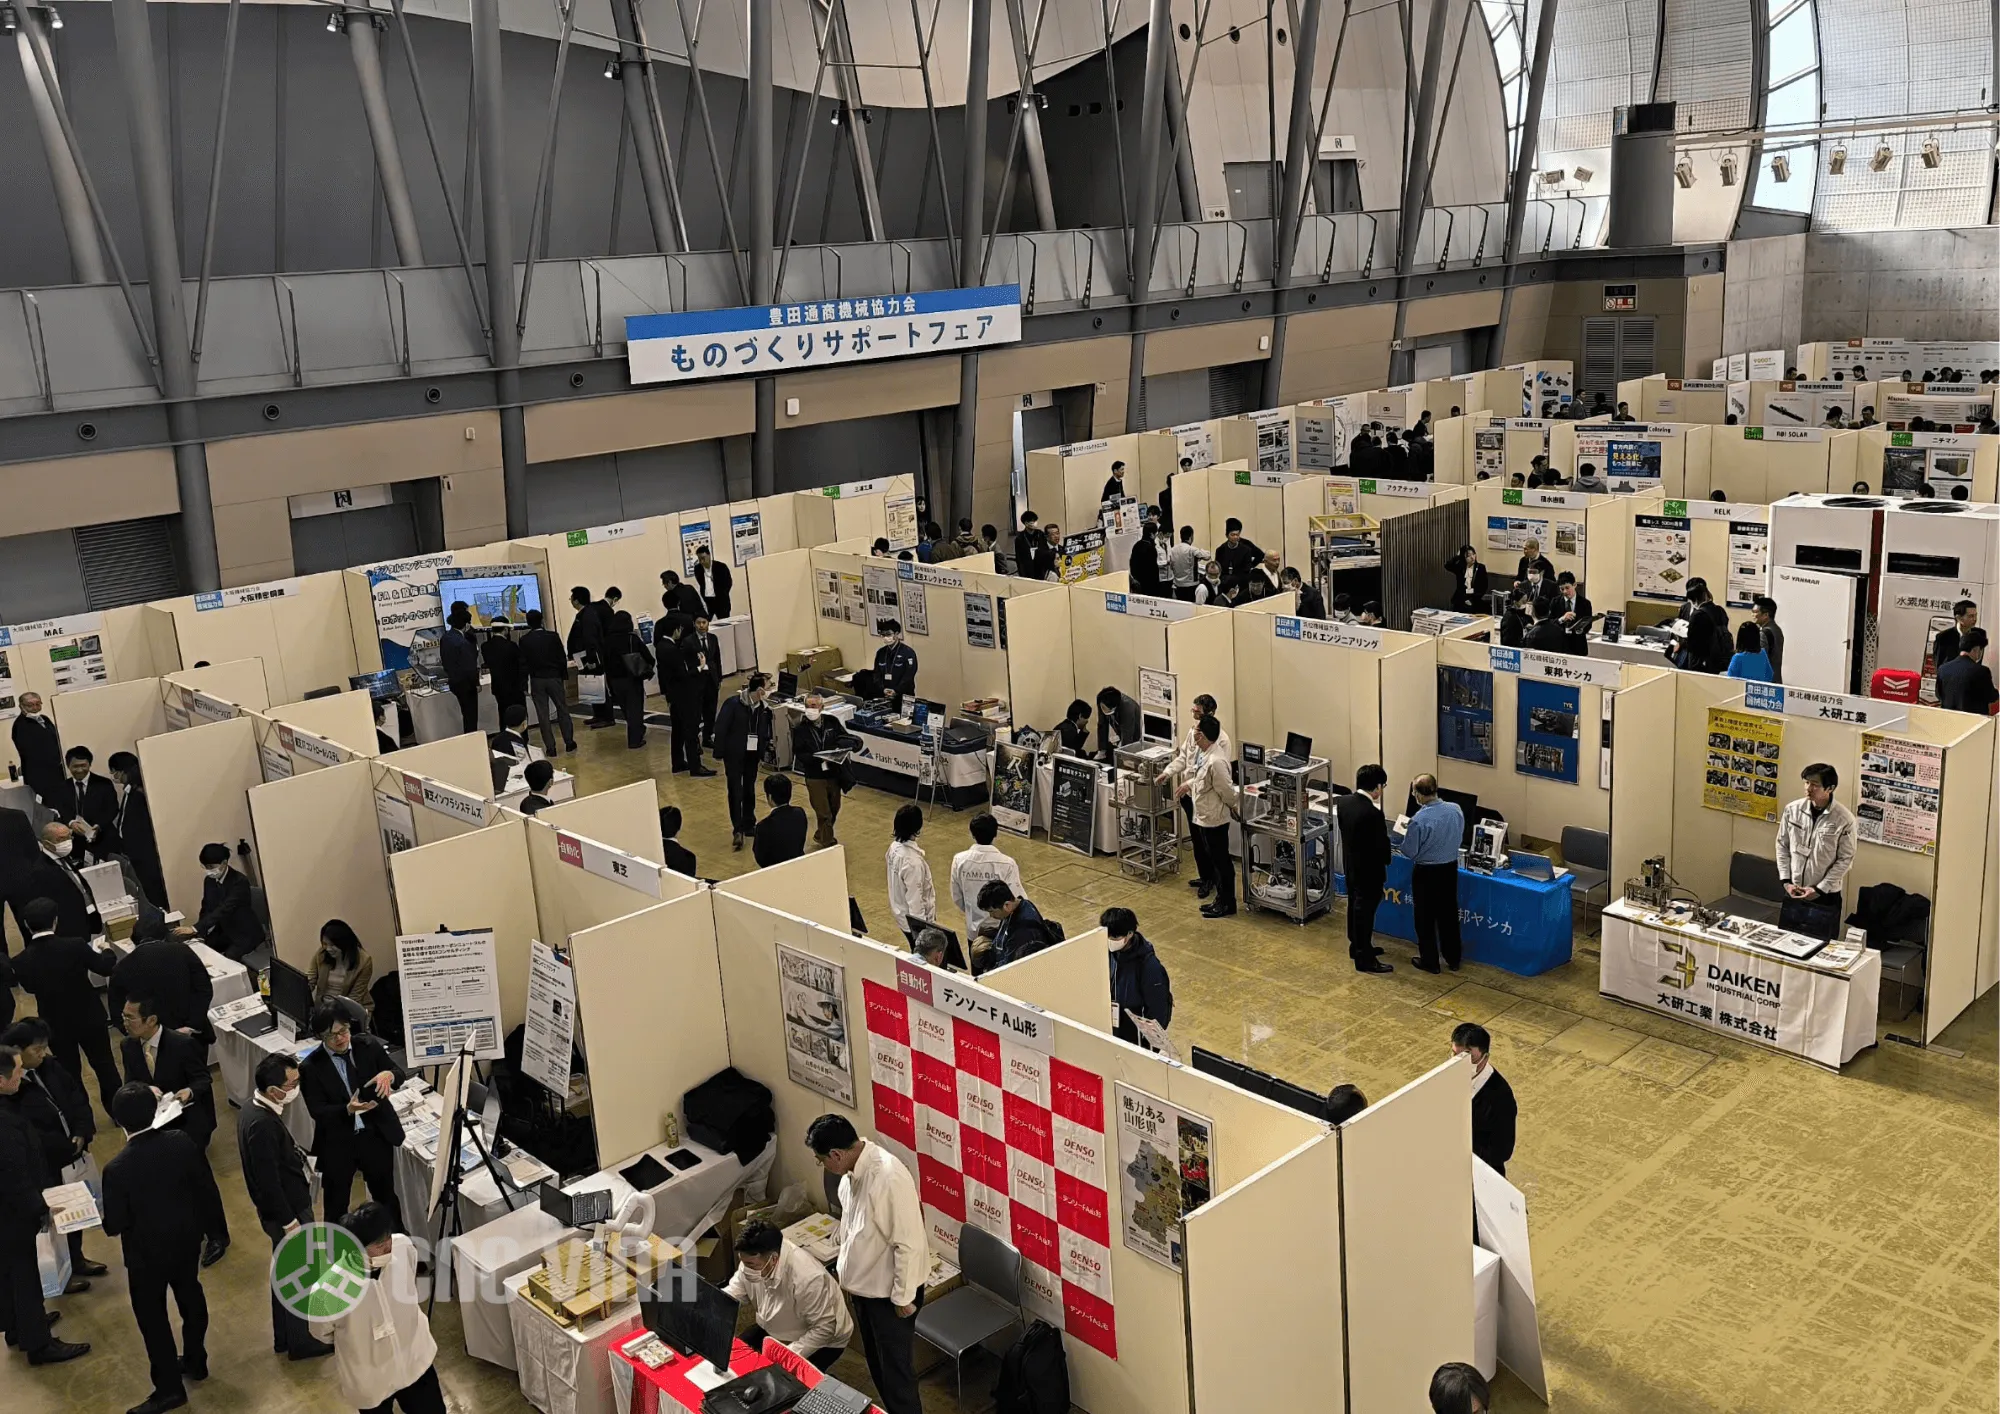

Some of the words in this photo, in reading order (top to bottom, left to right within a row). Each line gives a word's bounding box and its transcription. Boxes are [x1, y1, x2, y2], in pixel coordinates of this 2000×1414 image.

[768, 296, 917, 326] 豊田通商機械協力会
[670, 314, 995, 373] ものづくりサポートフェア
[1789, 430, 1808, 439] SOLAR
[1791, 575, 1820, 585] YANMAR
[377, 590, 390, 601] FA
[392, 589, 400, 600] &
[1896, 597, 1956, 611] 水素燃料電
[1149, 608, 1169, 619] エコム
[44, 627, 64, 638] MAE
[1523, 653, 1568, 666] 浜松機械協力会
[1544, 665, 1592, 682] 東邦ヤシカ
[1746, 684, 1776, 698] 豊田通商
[1788, 690, 1843, 706] 東北機械協力会
[1746, 697, 1783, 710] 機械協力会
[1819, 706, 1868, 724] 大研工業
[875, 752, 893, 765] Flash
[893, 757, 919, 771] Support
[424, 788, 483, 820] 東芝インフラシステムズ
[559, 840, 580, 859] 自動化
[612, 860, 629, 878] 東芝
[900, 970, 929, 994] 自動化
[1708, 964, 1781, 999] DAIKEN
[1707, 981, 1755, 1002] INDUSTRIAL
[1756, 997, 1784, 1010] CORP.
[943, 987, 1037, 1038] デンソーFA山形
[1657, 993, 1713, 1021] 大研工業
[1719, 1011, 1778, 1041] 株式会社
[918, 1018, 945, 1036] DENSO
[877, 1052, 904, 1070] DENSO
[1010, 1059, 1040, 1078] DENSO
[966, 1092, 995, 1110] DENSO
[1123, 1095, 1166, 1124] 魅力ある
[926, 1122, 952, 1142] DENSO
[1124, 1111, 1157, 1136] 山形県
[1064, 1138, 1095, 1158] DENSO
[1016, 1169, 1046, 1190] DENSO
[973, 1198, 1002, 1218] DENSO
[1070, 1249, 1101, 1271] DENSO
[1024, 1275, 1053, 1298] DENSO
